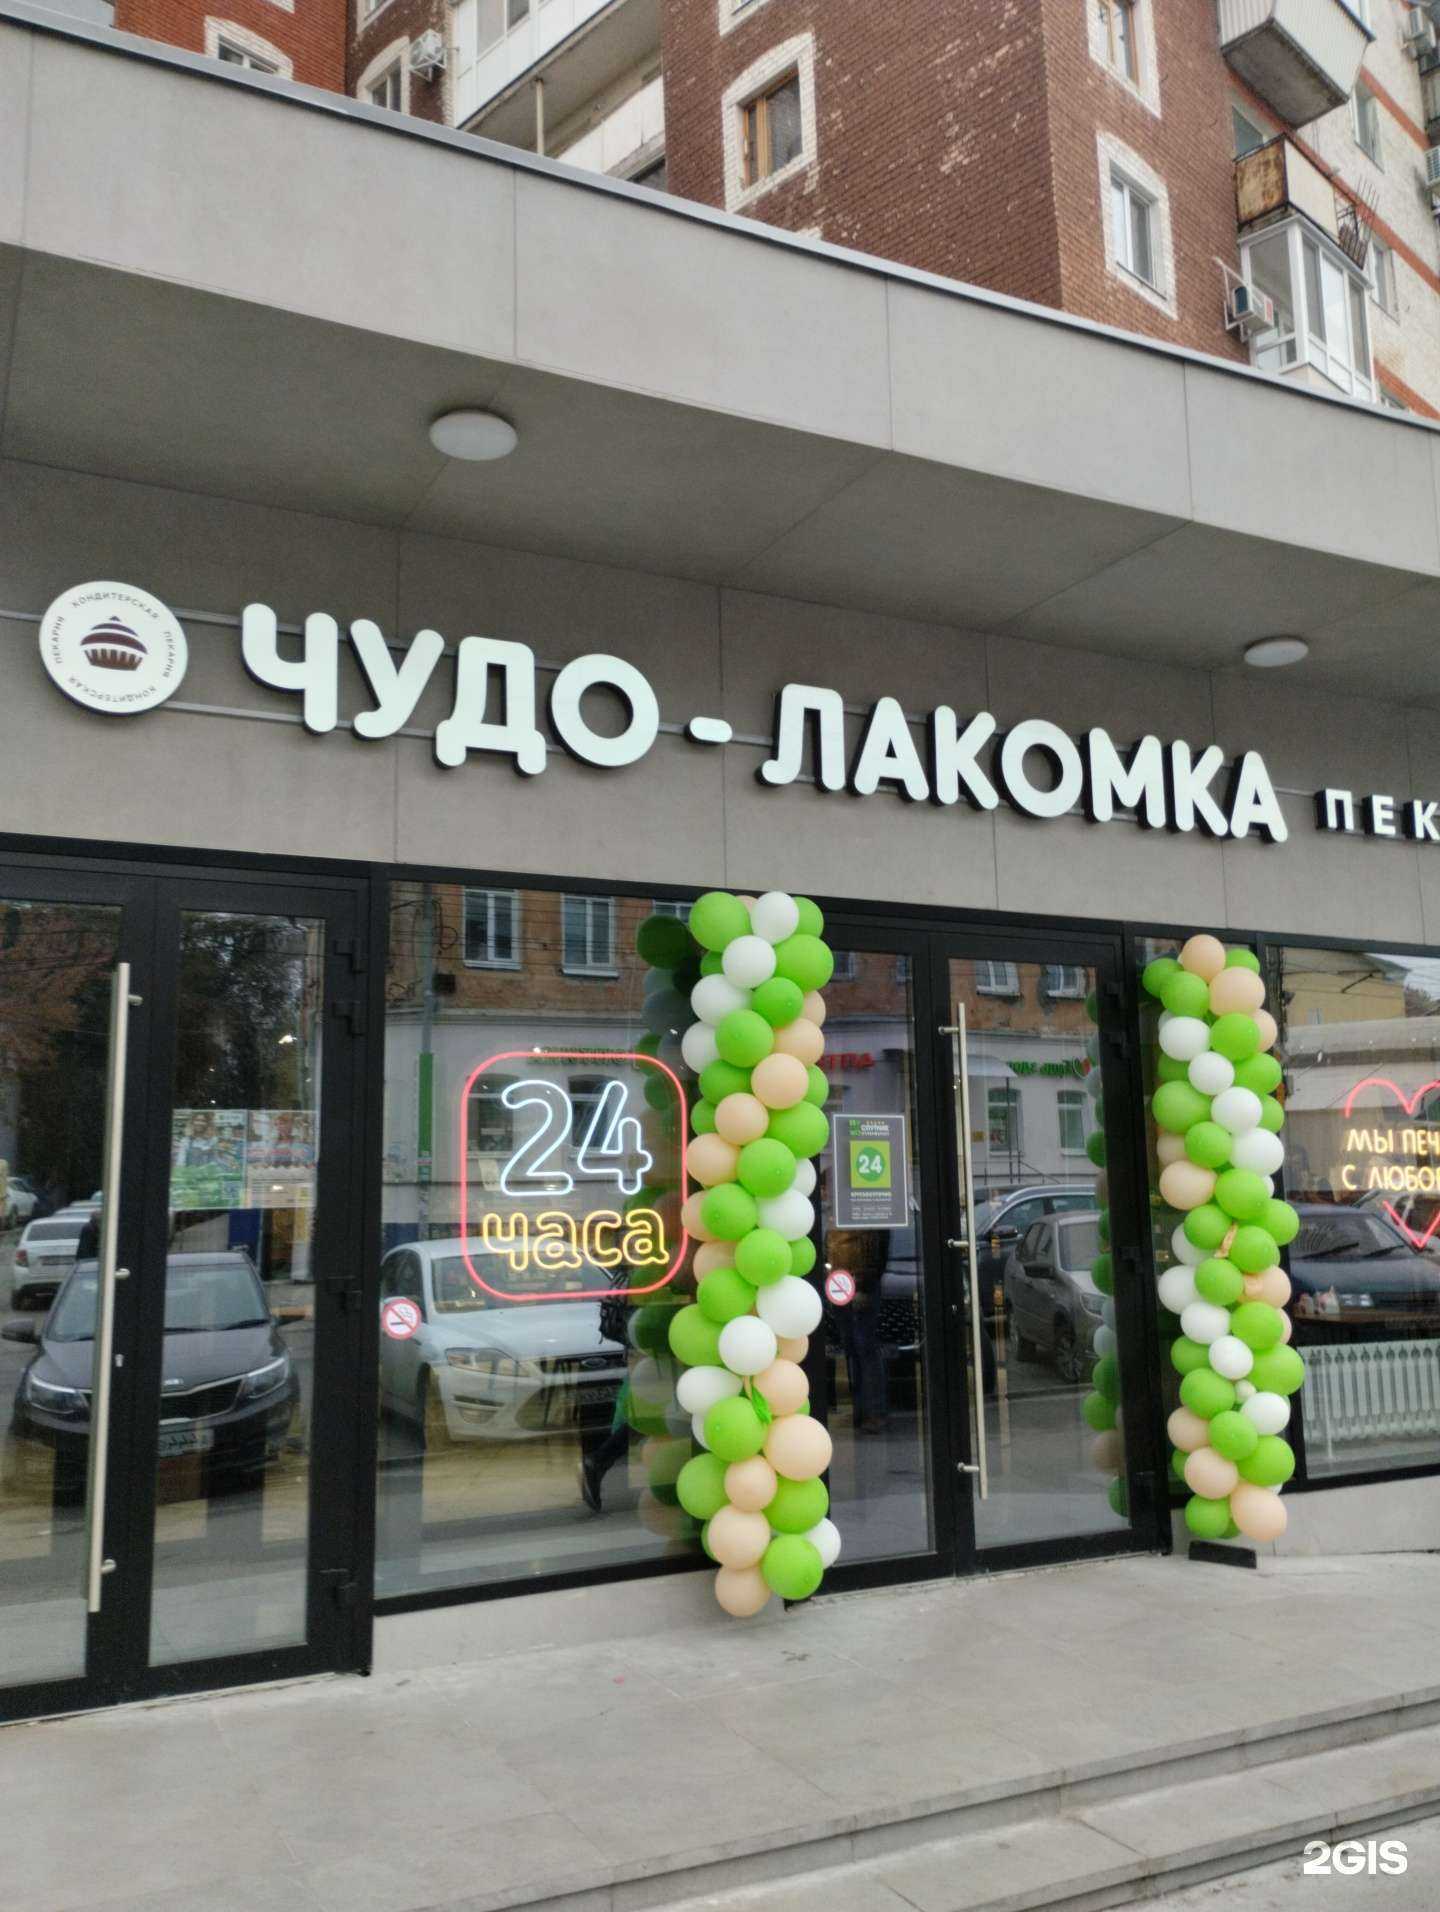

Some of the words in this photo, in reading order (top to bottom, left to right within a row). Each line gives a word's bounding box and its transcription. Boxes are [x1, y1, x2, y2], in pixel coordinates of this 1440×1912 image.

[72, 592, 160, 620] КОНДИТЕРСКАЯ
[51, 615, 65, 664] ПЕКАРНЯ
[163, 630, 177, 679] ПЕКАРНЯ
[68, 676, 157, 703] КОНДИТЕРСКАЯ
[242, 603, 660, 776] ЧУДО
[762, 683, 1289, 843] ЛАКОМКА
[1325, 788, 1440, 841] ПЕК
[500, 1078, 654, 1197] 24
[1346, 1128, 1394, 1154] МЫ
[1402, 1128, 1440, 1156] ПЕЧ
[858, 1154, 882, 1174] 24
[1341, 1164, 1358, 1191] С
[482, 1208, 671, 1271] часа
